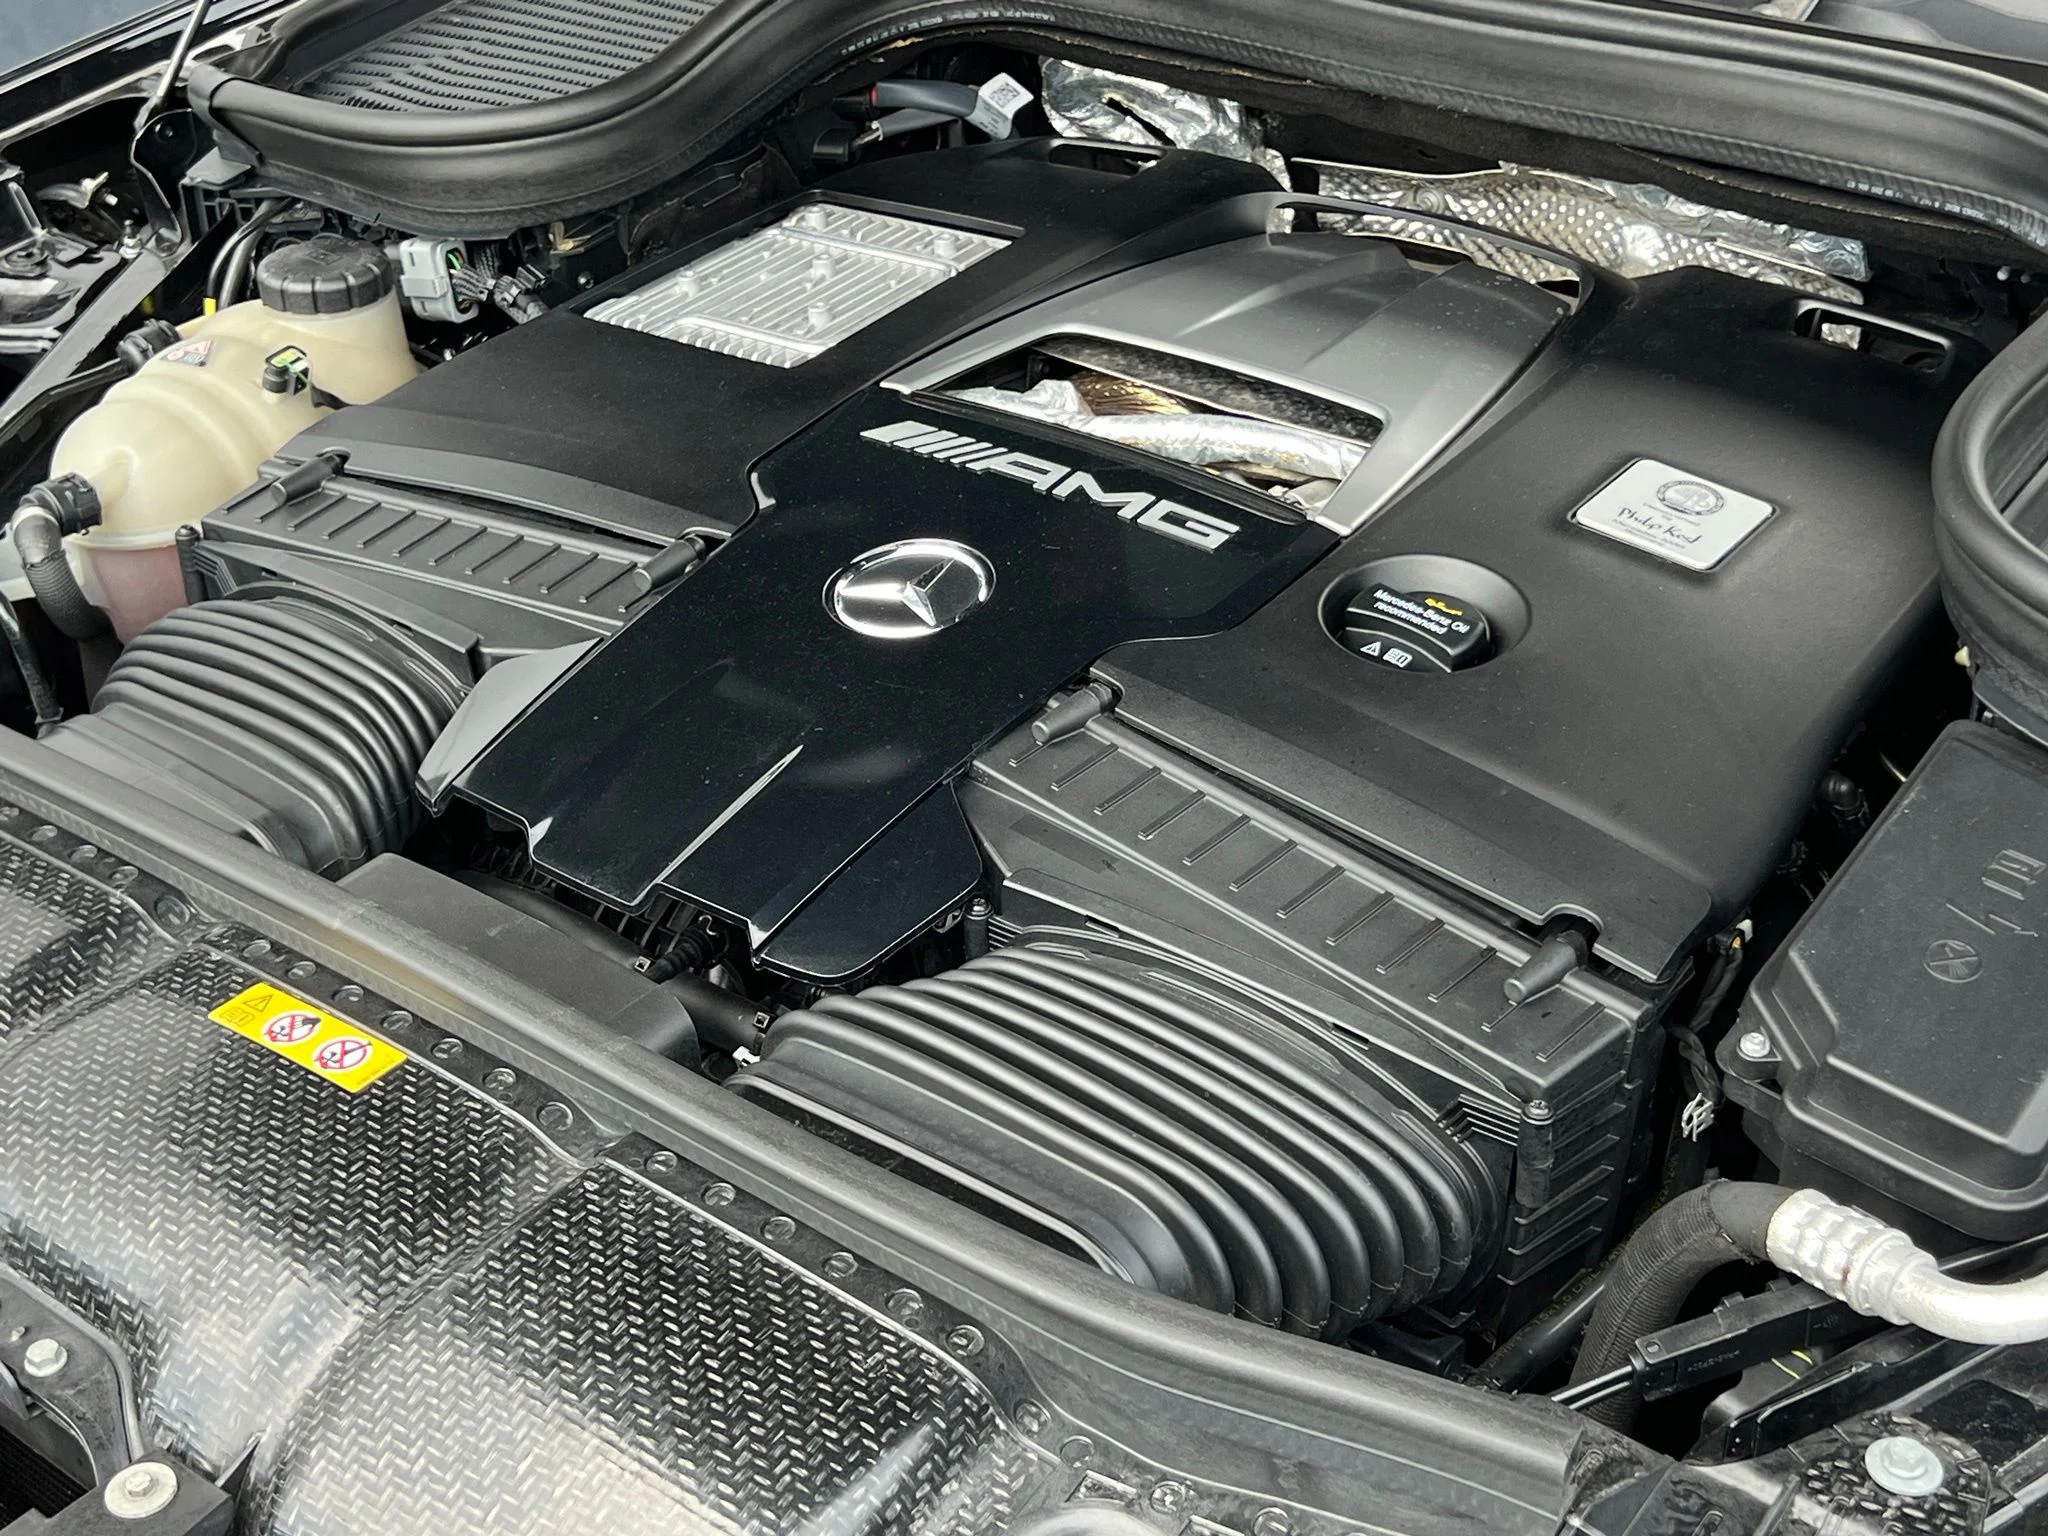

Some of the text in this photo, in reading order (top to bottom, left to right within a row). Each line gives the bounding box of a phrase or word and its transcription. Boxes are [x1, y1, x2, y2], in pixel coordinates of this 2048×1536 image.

[965, 448, 1241, 553] AMG
[1373, 588, 1471, 634] Mercedes-Benz Oil
[1373, 601, 1449, 635] recommended
